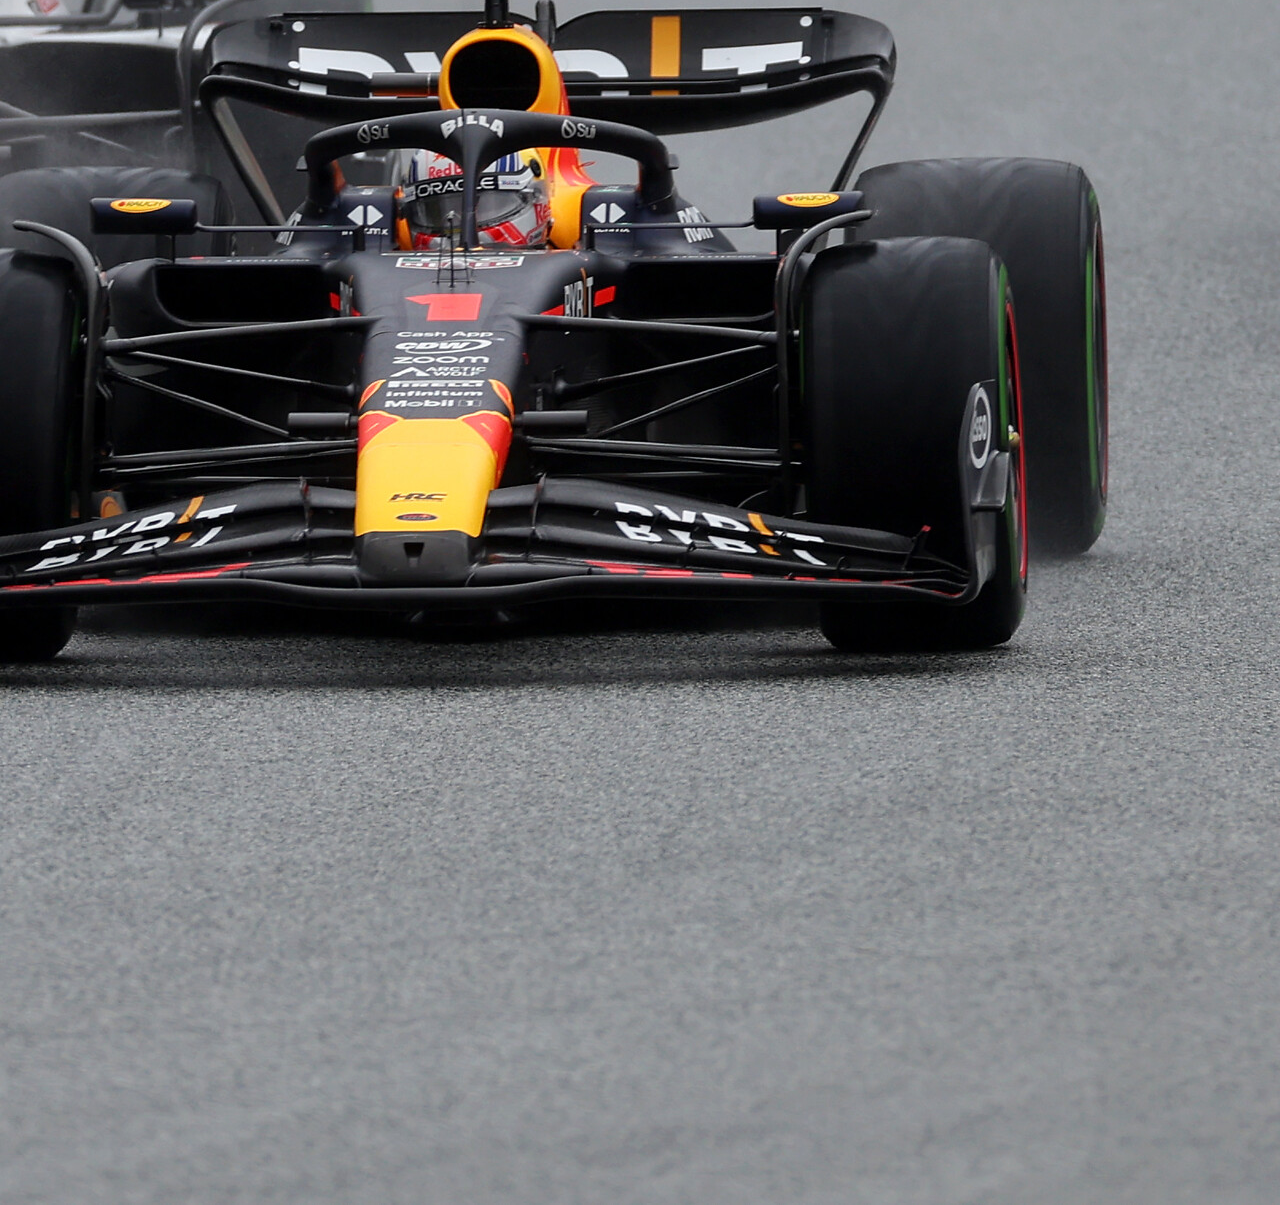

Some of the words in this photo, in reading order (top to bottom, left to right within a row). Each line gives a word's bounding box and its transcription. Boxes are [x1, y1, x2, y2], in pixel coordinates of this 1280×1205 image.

[370, 124, 390, 140] Sui
[440, 114, 505, 140] BILLA
[576, 122, 597, 139] Sui
[428, 162, 452, 180] Red
[404, 293, 483, 323] 1
[451, 330, 494, 338] App
[392, 356, 490, 364] zoom
[387, 379, 485, 388] PIRELLI
[384, 399, 455, 408] Mobil
[388, 492, 448, 503] HRC
